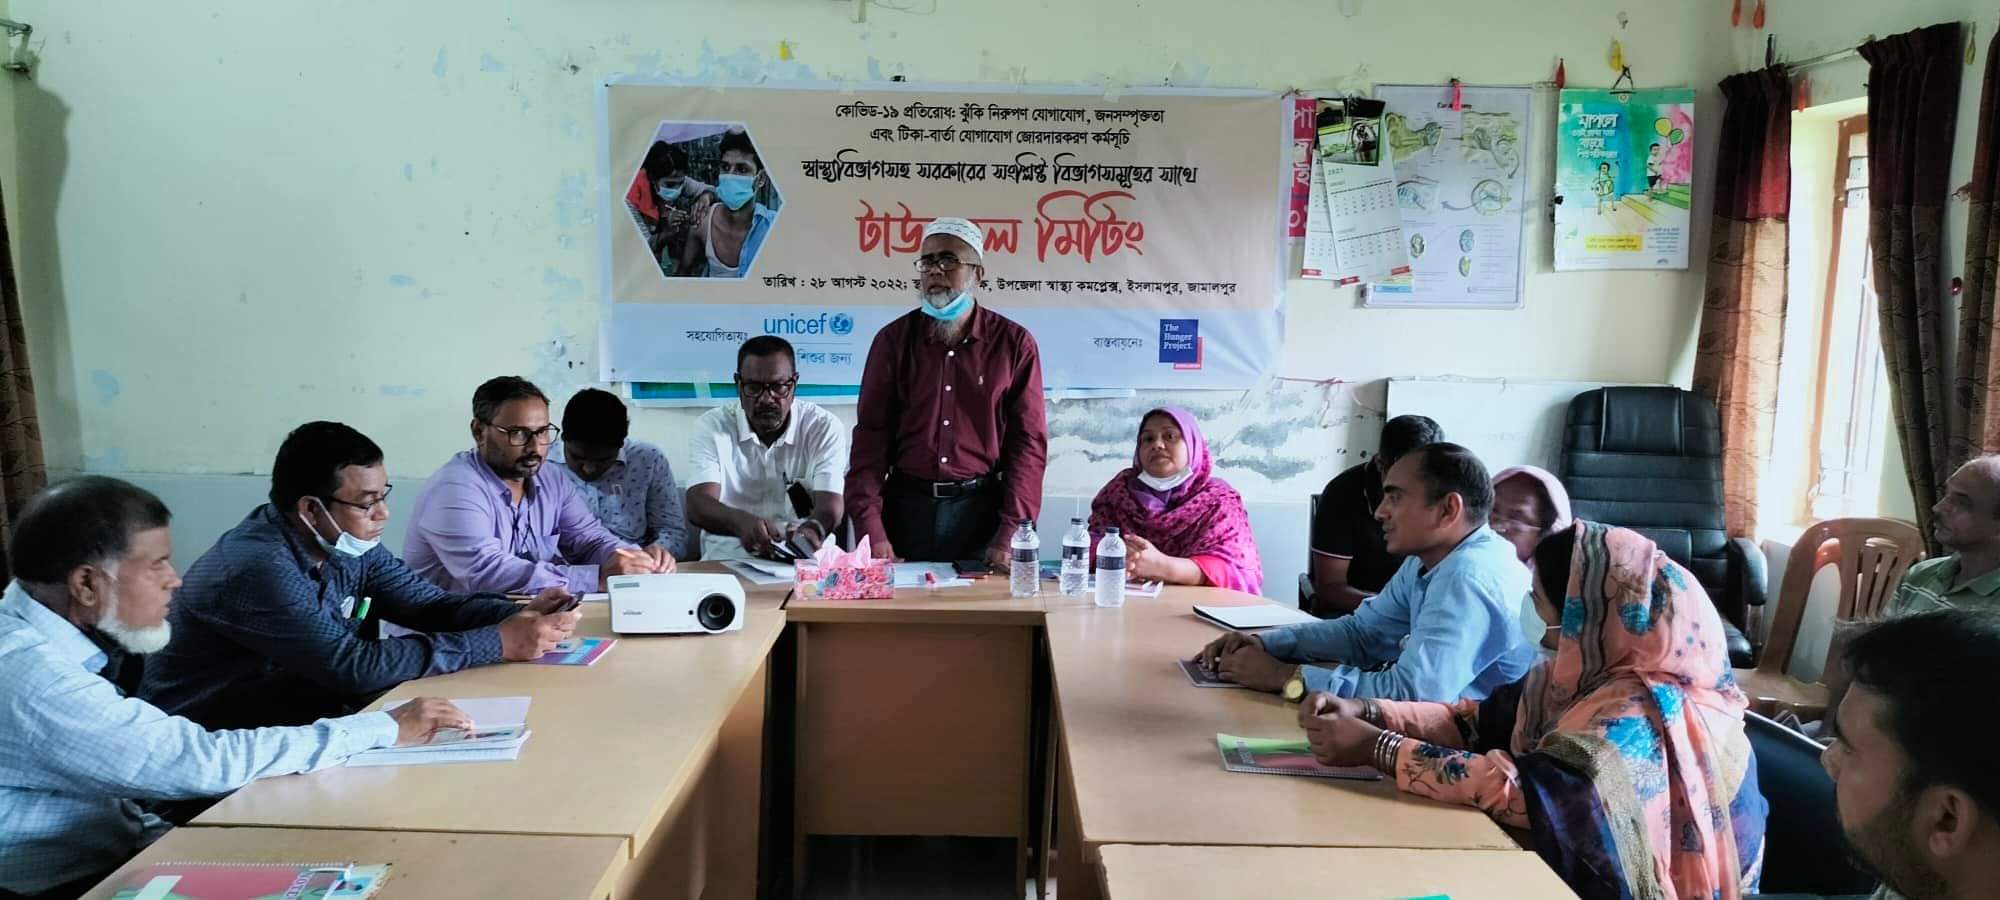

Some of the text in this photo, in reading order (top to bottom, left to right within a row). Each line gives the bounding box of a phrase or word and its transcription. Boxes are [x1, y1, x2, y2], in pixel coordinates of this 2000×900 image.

[835, 101, 899, 118] কোভিড-১৯
[959, 103, 984, 124] ঝুঁকি
[1032, 108, 1091, 124] যোগাযোগ,
[1095, 109, 1165, 127] জনসম্পৃক্ততা
[870, 125, 1132, 149] এবং টিকা-বার্তা যোগাযোগ জোরদারকরণ কর্মসূচি
[915, 161, 986, 184] সরকারের
[991, 152, 1048, 184] সংশ্লিষ্ট
[1053, 152, 1153, 189] বিভাগসমূহের
[1159, 164, 1198, 185] সাথে
[1034, 190, 1144, 264] মিটিং
[762, 273, 797, 288] তারিখ
[810, 277, 827, 290] ২৮
[831, 275, 867, 289] আগস্ট
[997, 277, 1042, 292] উপজেলা
[1045, 280, 1073, 293] স্বাস্থ্য
[1126, 278, 1183, 296] ইসলামপুর,
[1186, 282, 1237, 296] জামালপুর
[764, 313, 827, 335] unicef
[1163, 323, 1179, 332] The
[1163, 333, 1192, 343] Hunger
